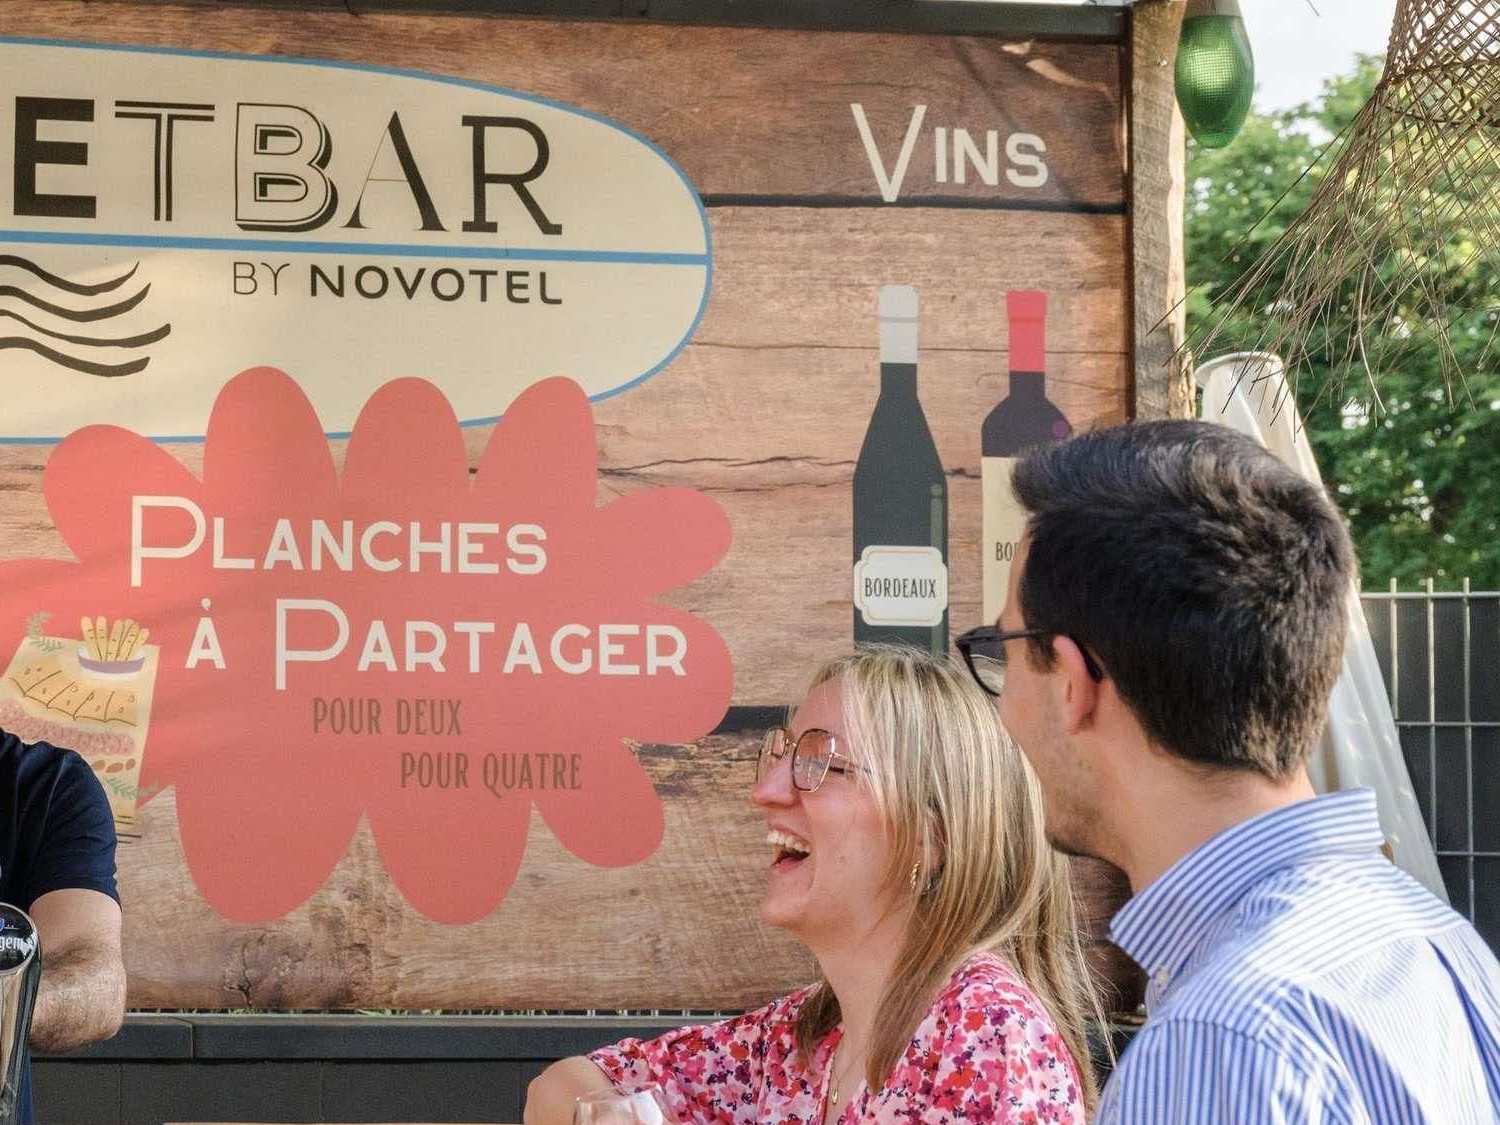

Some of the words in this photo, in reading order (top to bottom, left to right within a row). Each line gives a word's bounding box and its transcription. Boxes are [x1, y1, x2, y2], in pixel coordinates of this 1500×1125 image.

[850, 103, 1049, 203] VINS
[233, 261, 291, 296] BY
[310, 263, 563, 306] NOVOTEL
[130, 494, 548, 588] PLANCHES
[864, 577, 937, 599] BORDEAUX
[275, 598, 688, 691] PARTAGER
[312, 697, 382, 735] POUR
[396, 698, 463, 736] DEUX
[400, 751, 470, 789] POUR
[483, 752, 583, 799] QUATRE
